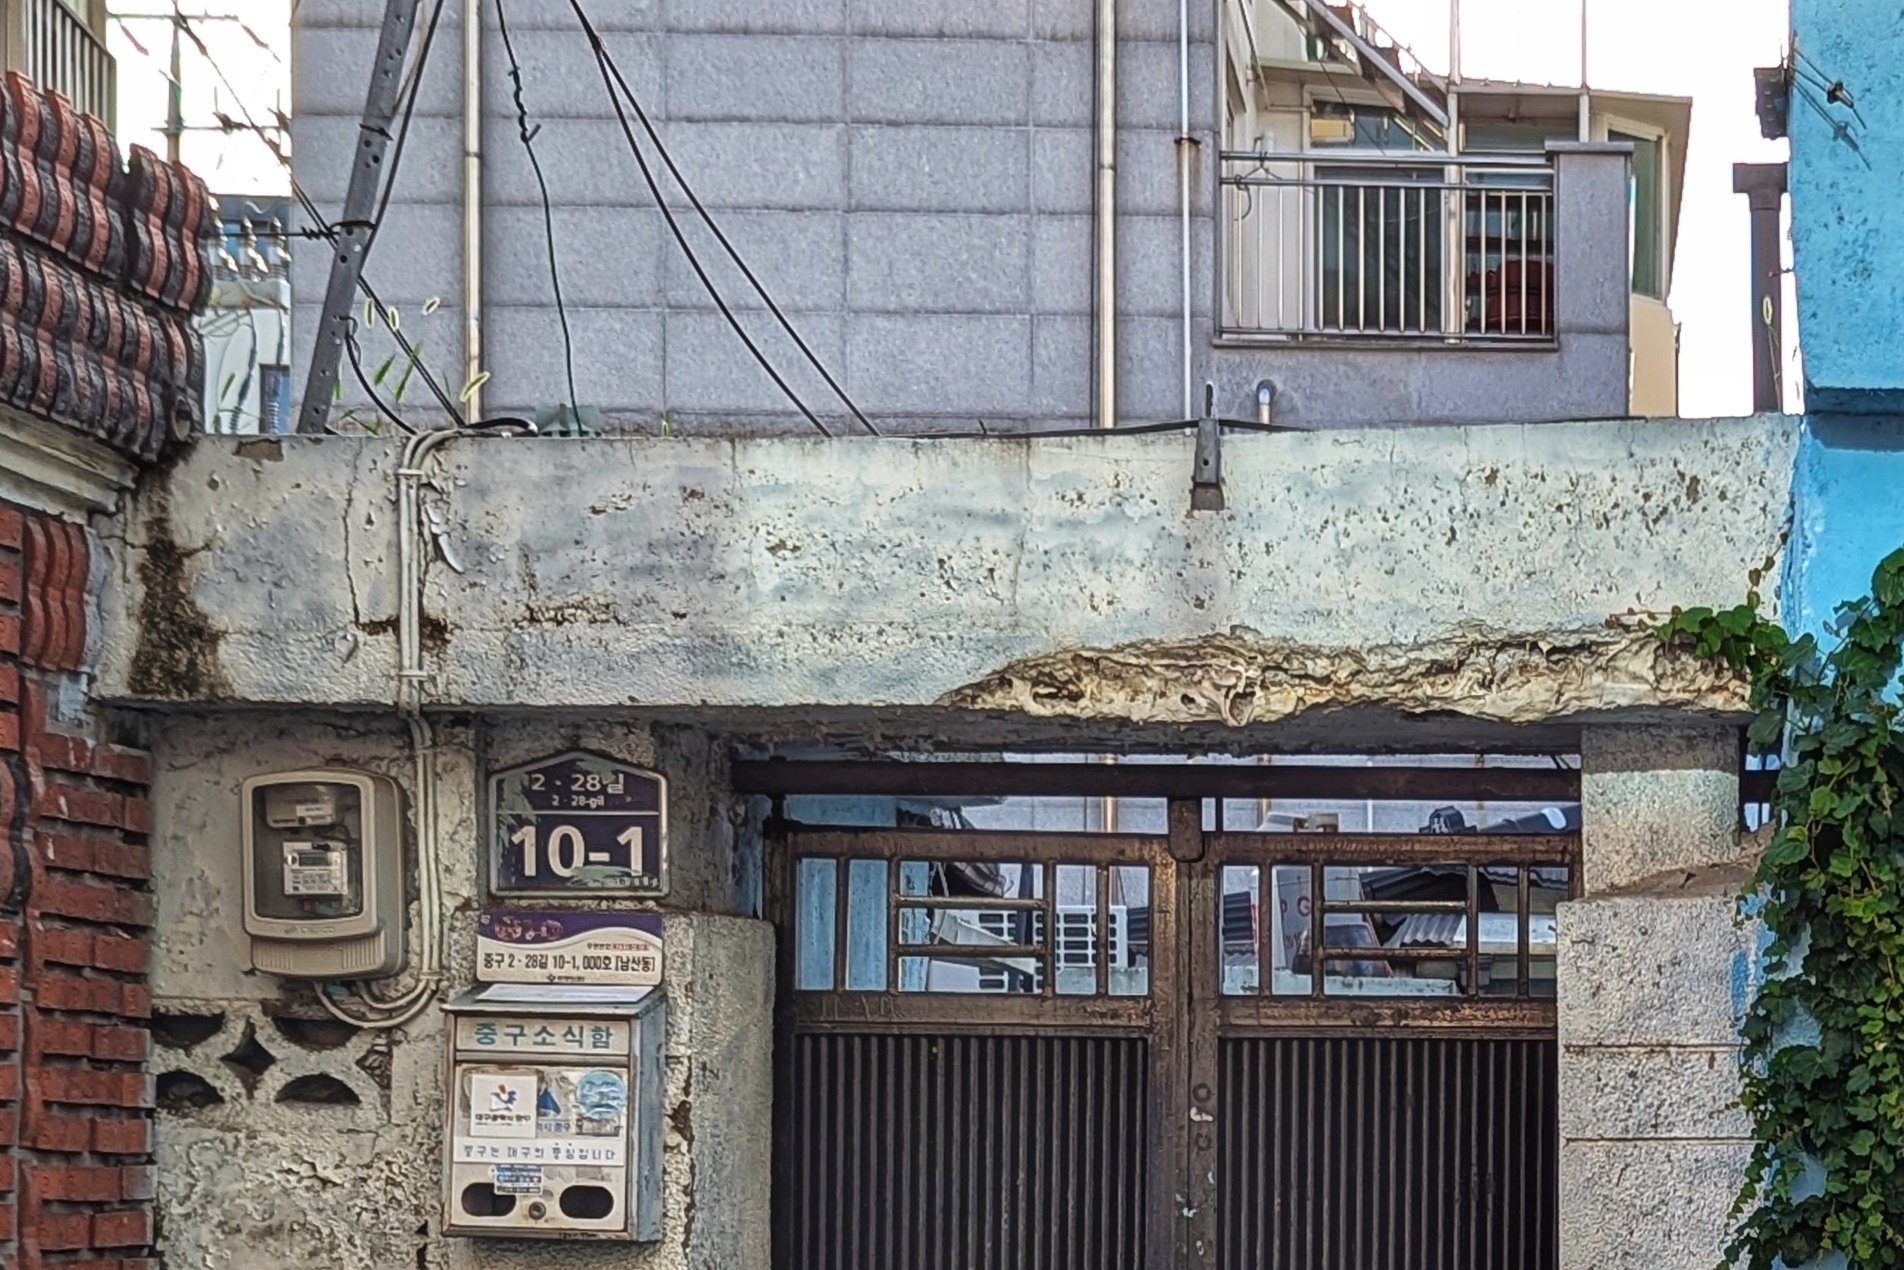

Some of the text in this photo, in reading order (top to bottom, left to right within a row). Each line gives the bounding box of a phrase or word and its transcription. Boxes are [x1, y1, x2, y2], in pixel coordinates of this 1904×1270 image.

[531, 773, 546, 791] 2
[551, 794, 559, 806] 2
[511, 825, 643, 878] 10-1
[483, 953, 505, 970] 중구
[508, 954, 515, 968] 2
[525, 954, 548, 970] 28길
[474, 1022, 614, 1049] 중구소식함
[507, 1146, 544, 1159] 대구의
